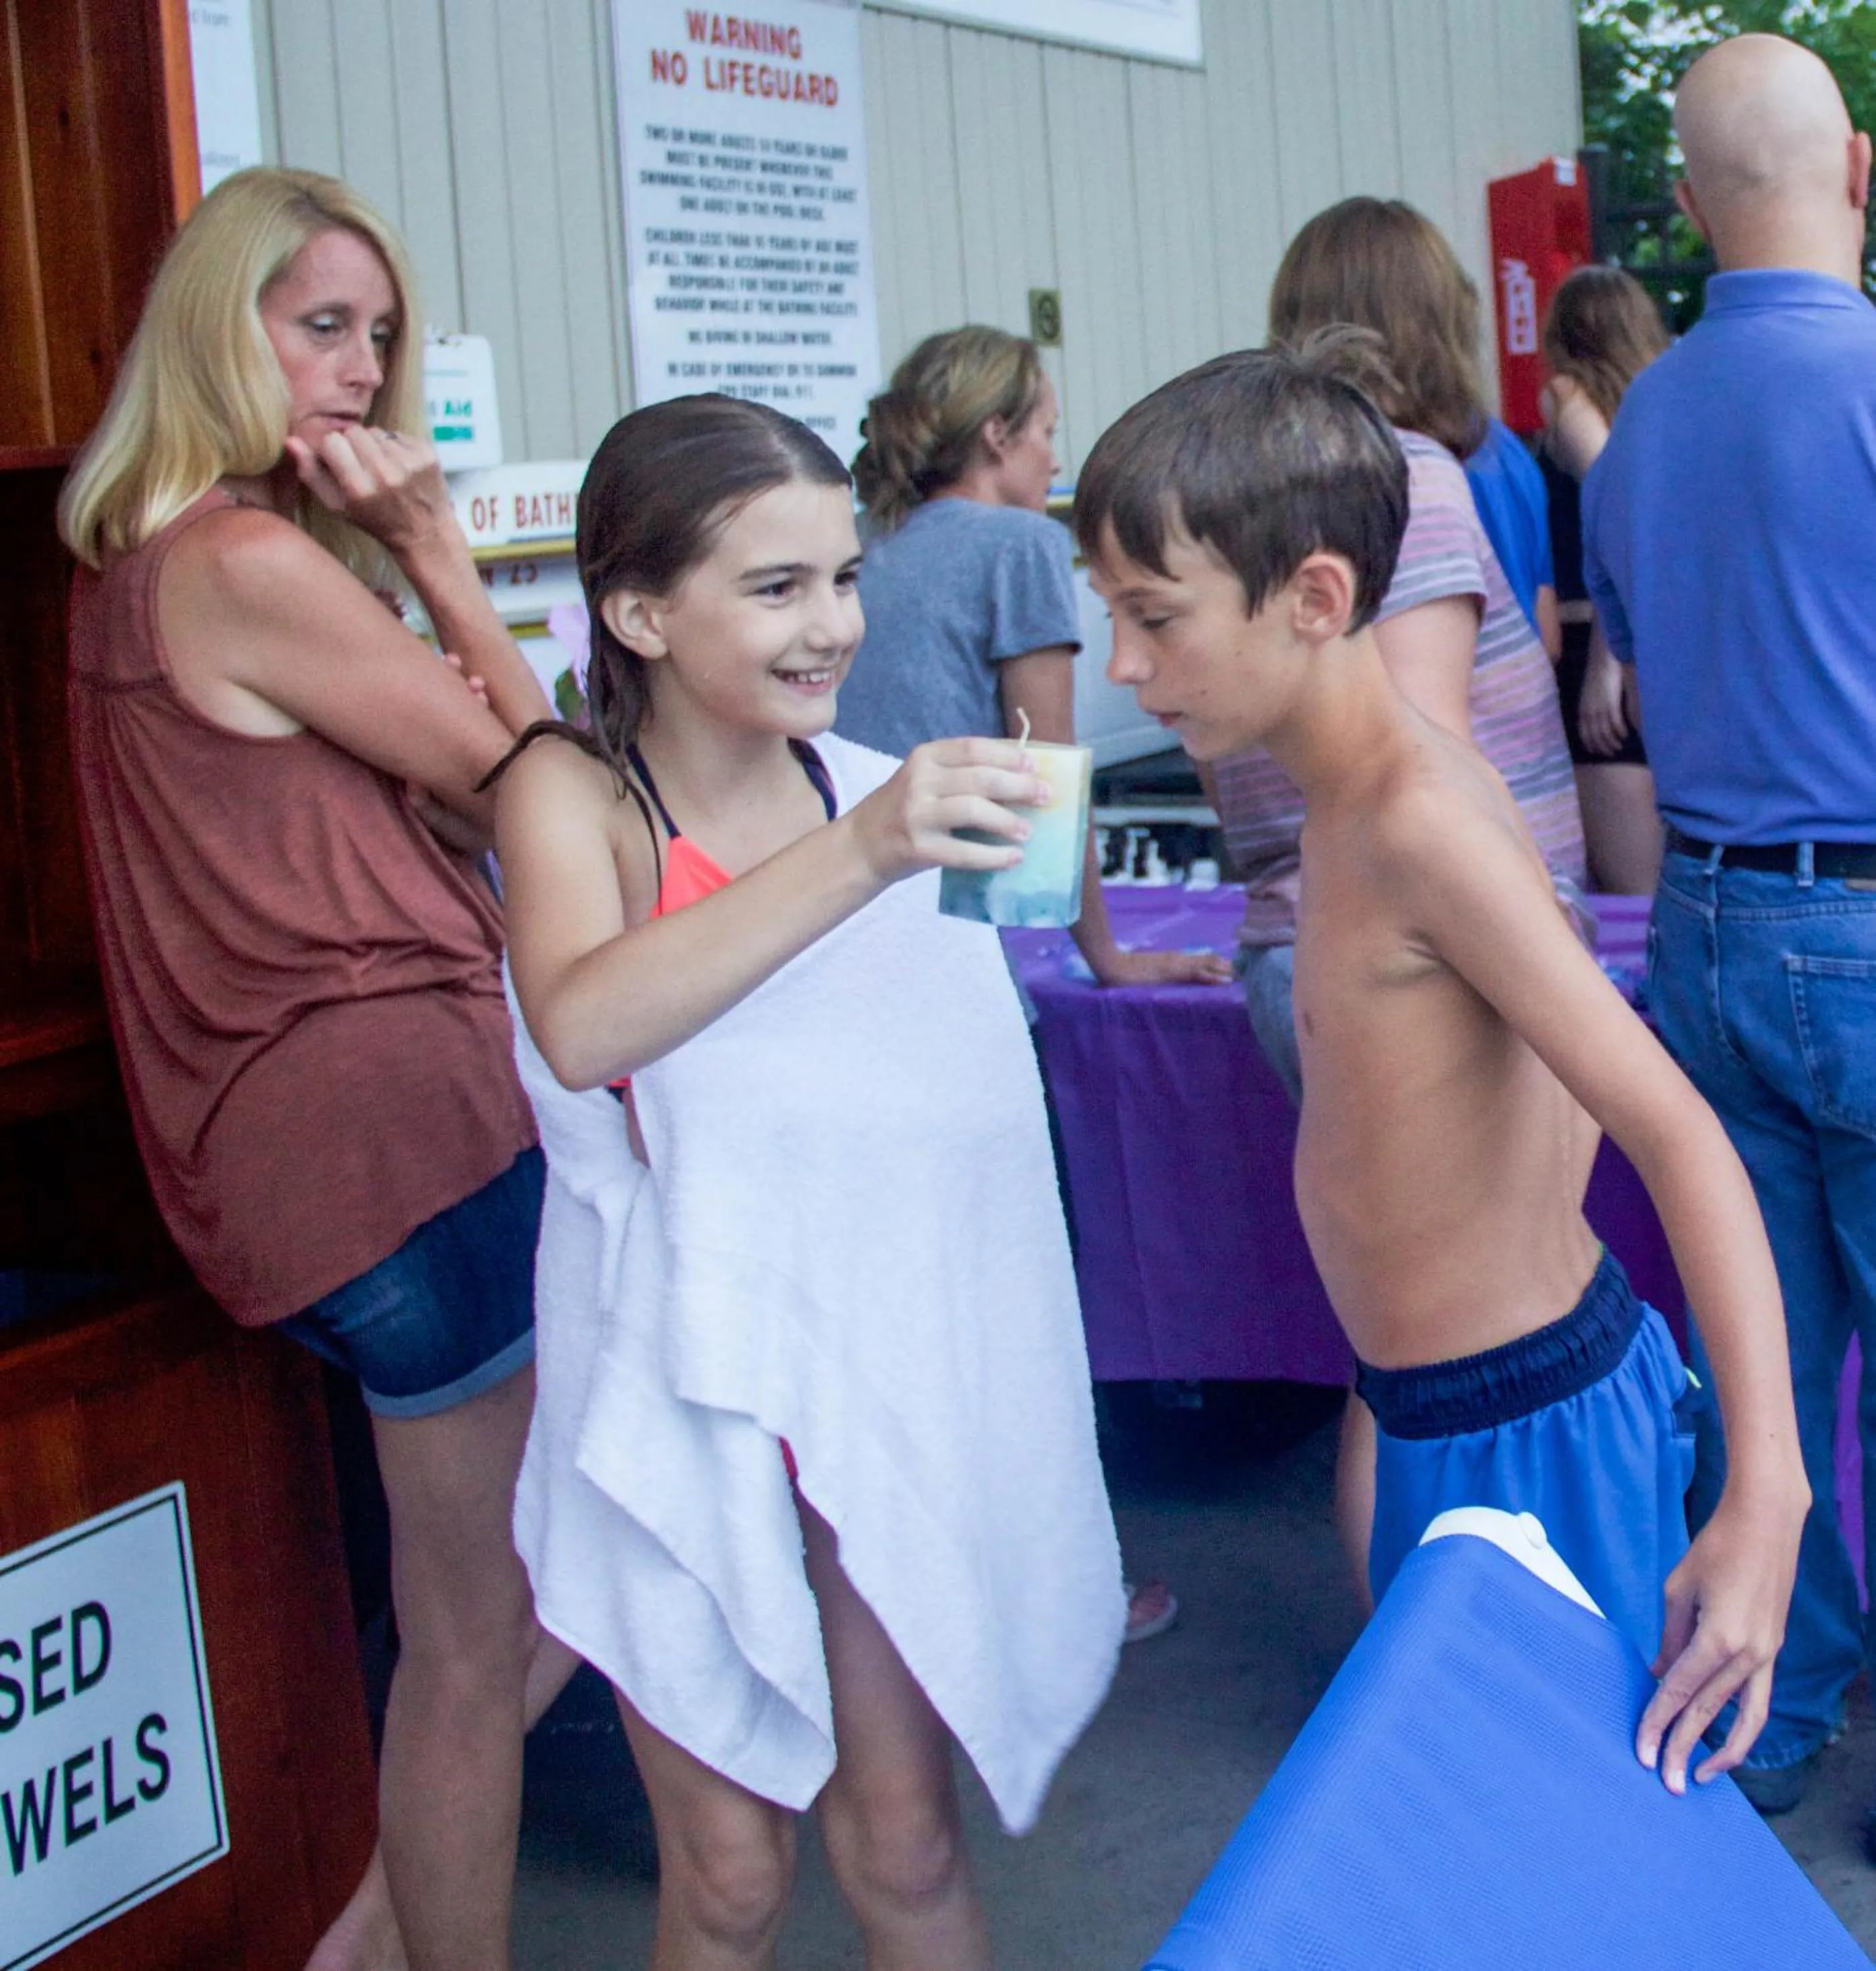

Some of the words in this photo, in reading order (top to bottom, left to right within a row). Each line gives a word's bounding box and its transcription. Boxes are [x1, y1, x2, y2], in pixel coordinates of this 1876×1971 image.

[686, 9, 802, 60] WARNING
[650, 49, 687, 85] NO
[704, 56, 838, 107] LIFEGUARD
[472, 495, 498, 532] OF
[514, 491, 578, 529] BATH
[0, 1601, 112, 1734] SED
[1, 1713, 171, 1877] WELS
